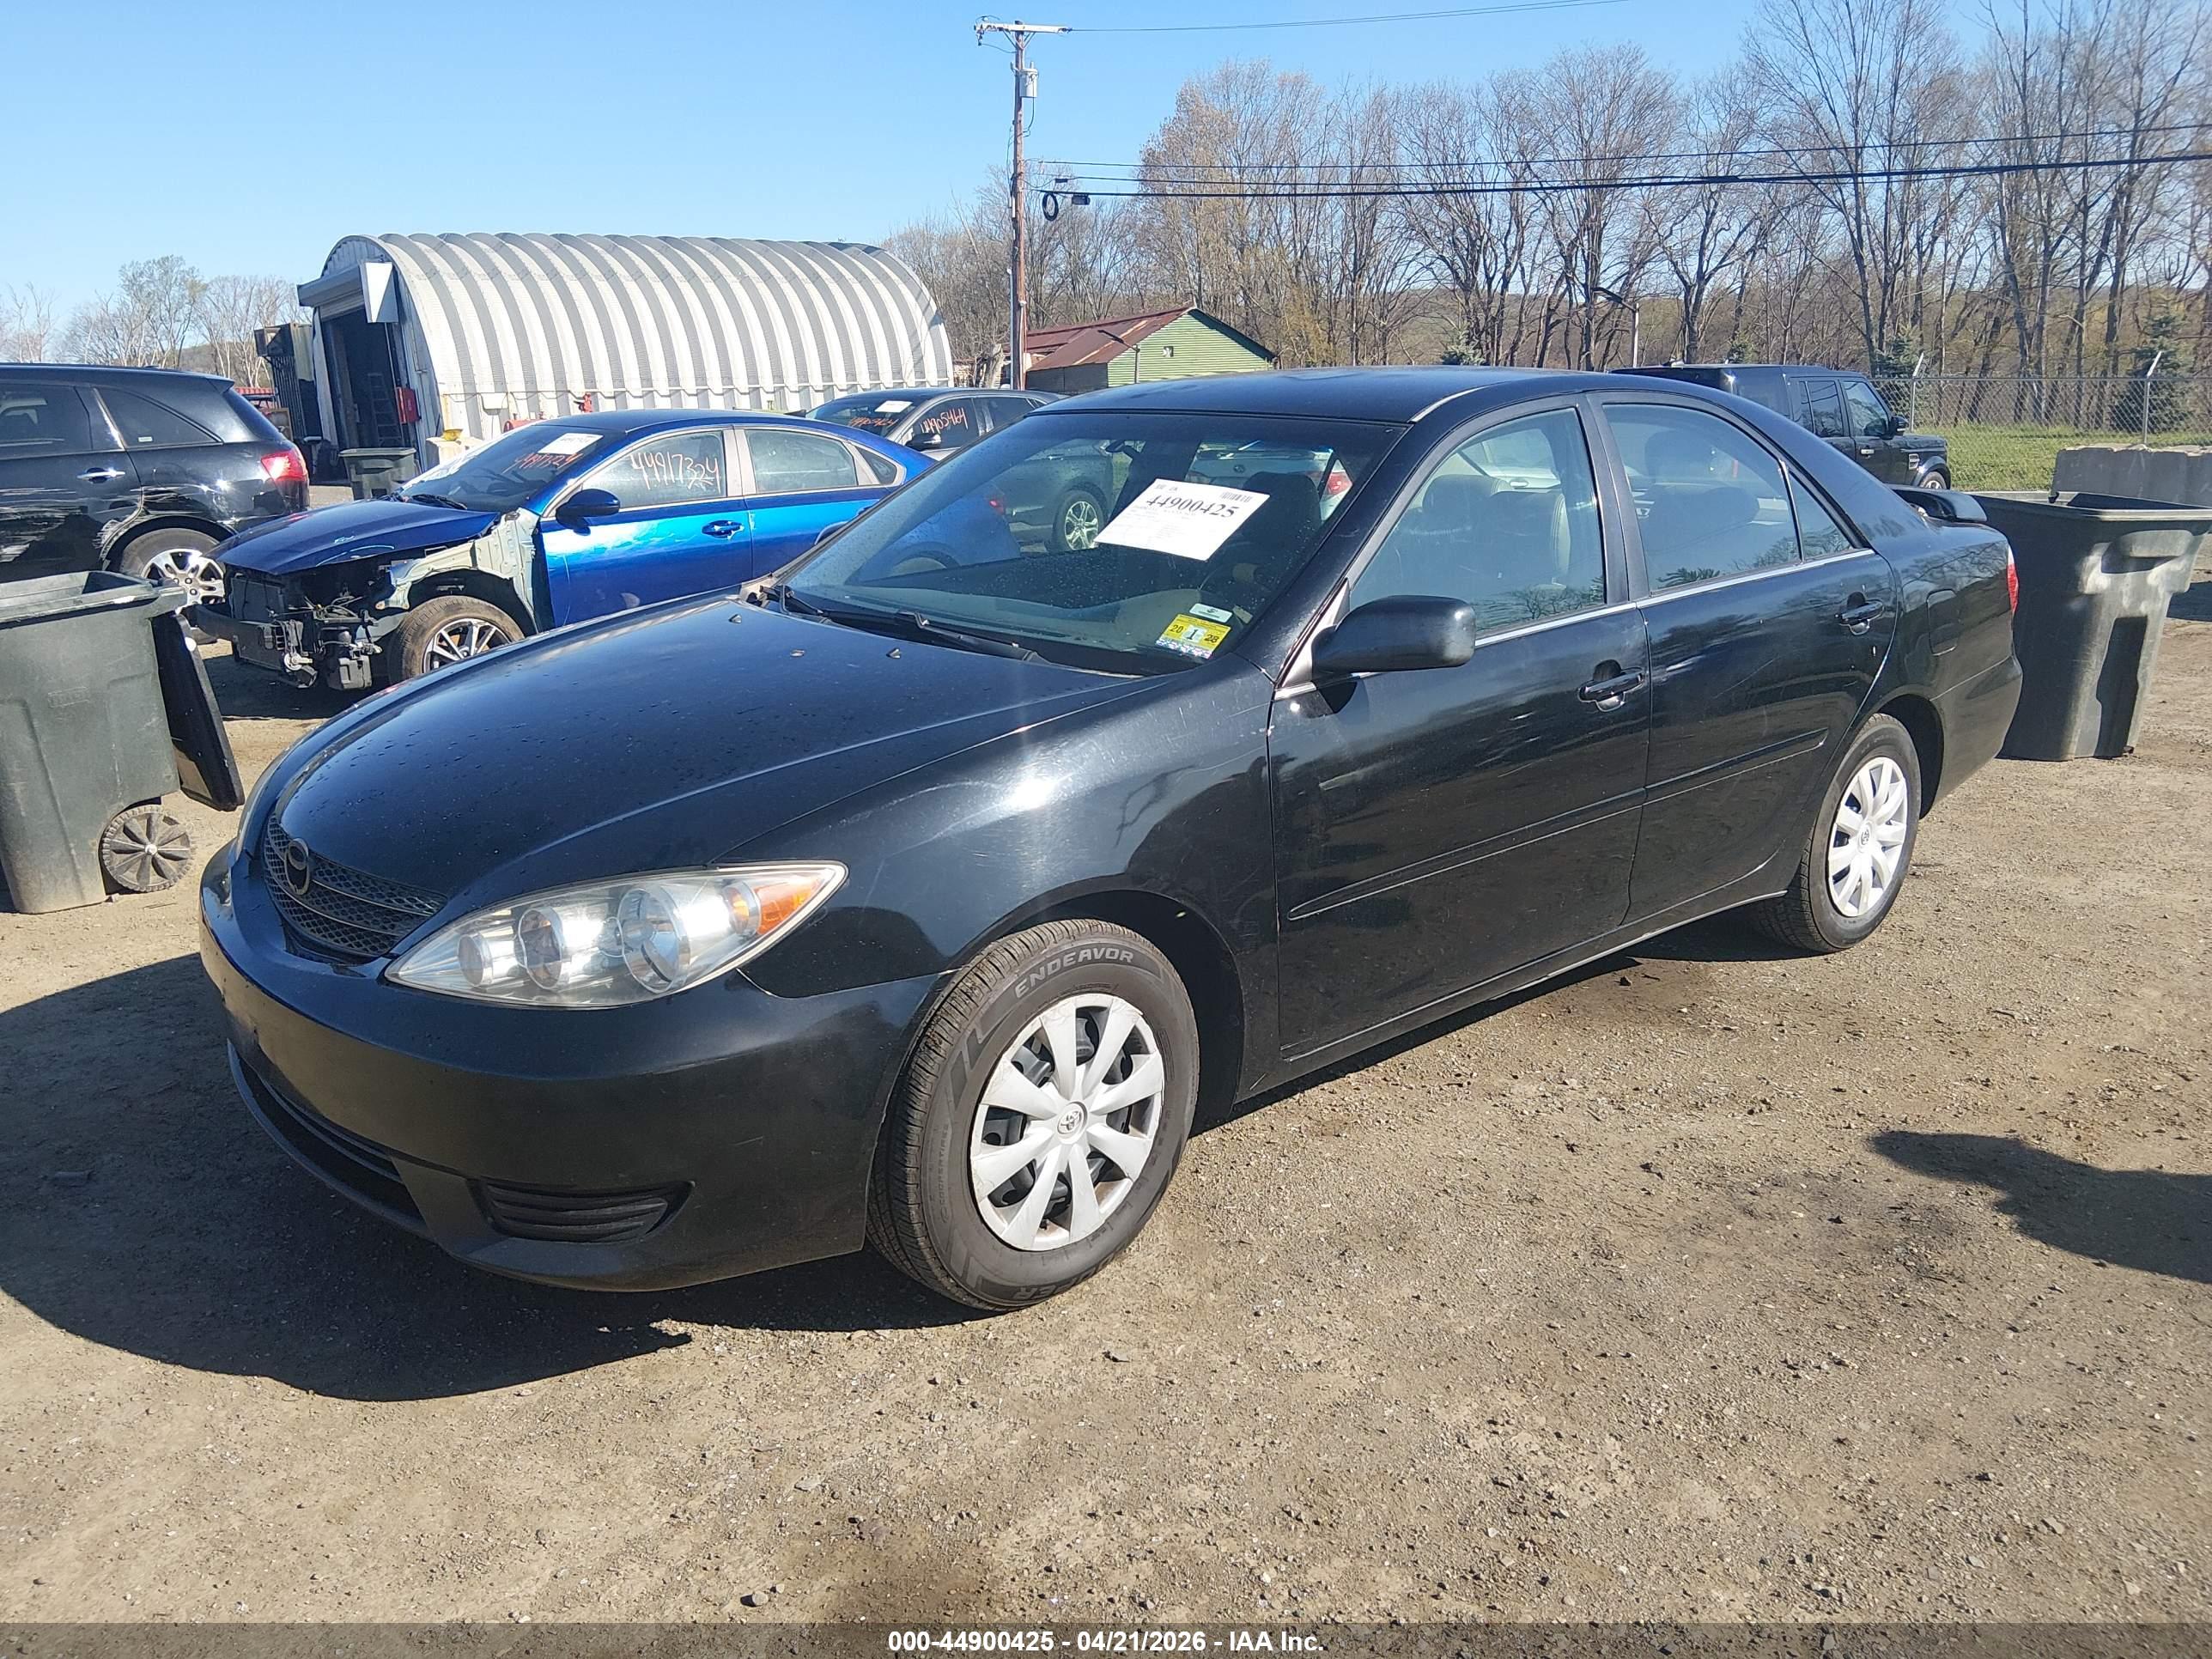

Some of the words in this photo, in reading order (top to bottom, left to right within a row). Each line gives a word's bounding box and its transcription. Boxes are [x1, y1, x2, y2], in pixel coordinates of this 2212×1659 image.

[629, 451, 722, 494] 44917324
[1146, 495, 1240, 518] 44900425
[1170, 624, 1184, 634] 20
[1187, 629, 1199, 641] 1
[1204, 634, 1219, 643] 28
[1015, 947, 1134, 999] ENDEAVOR
